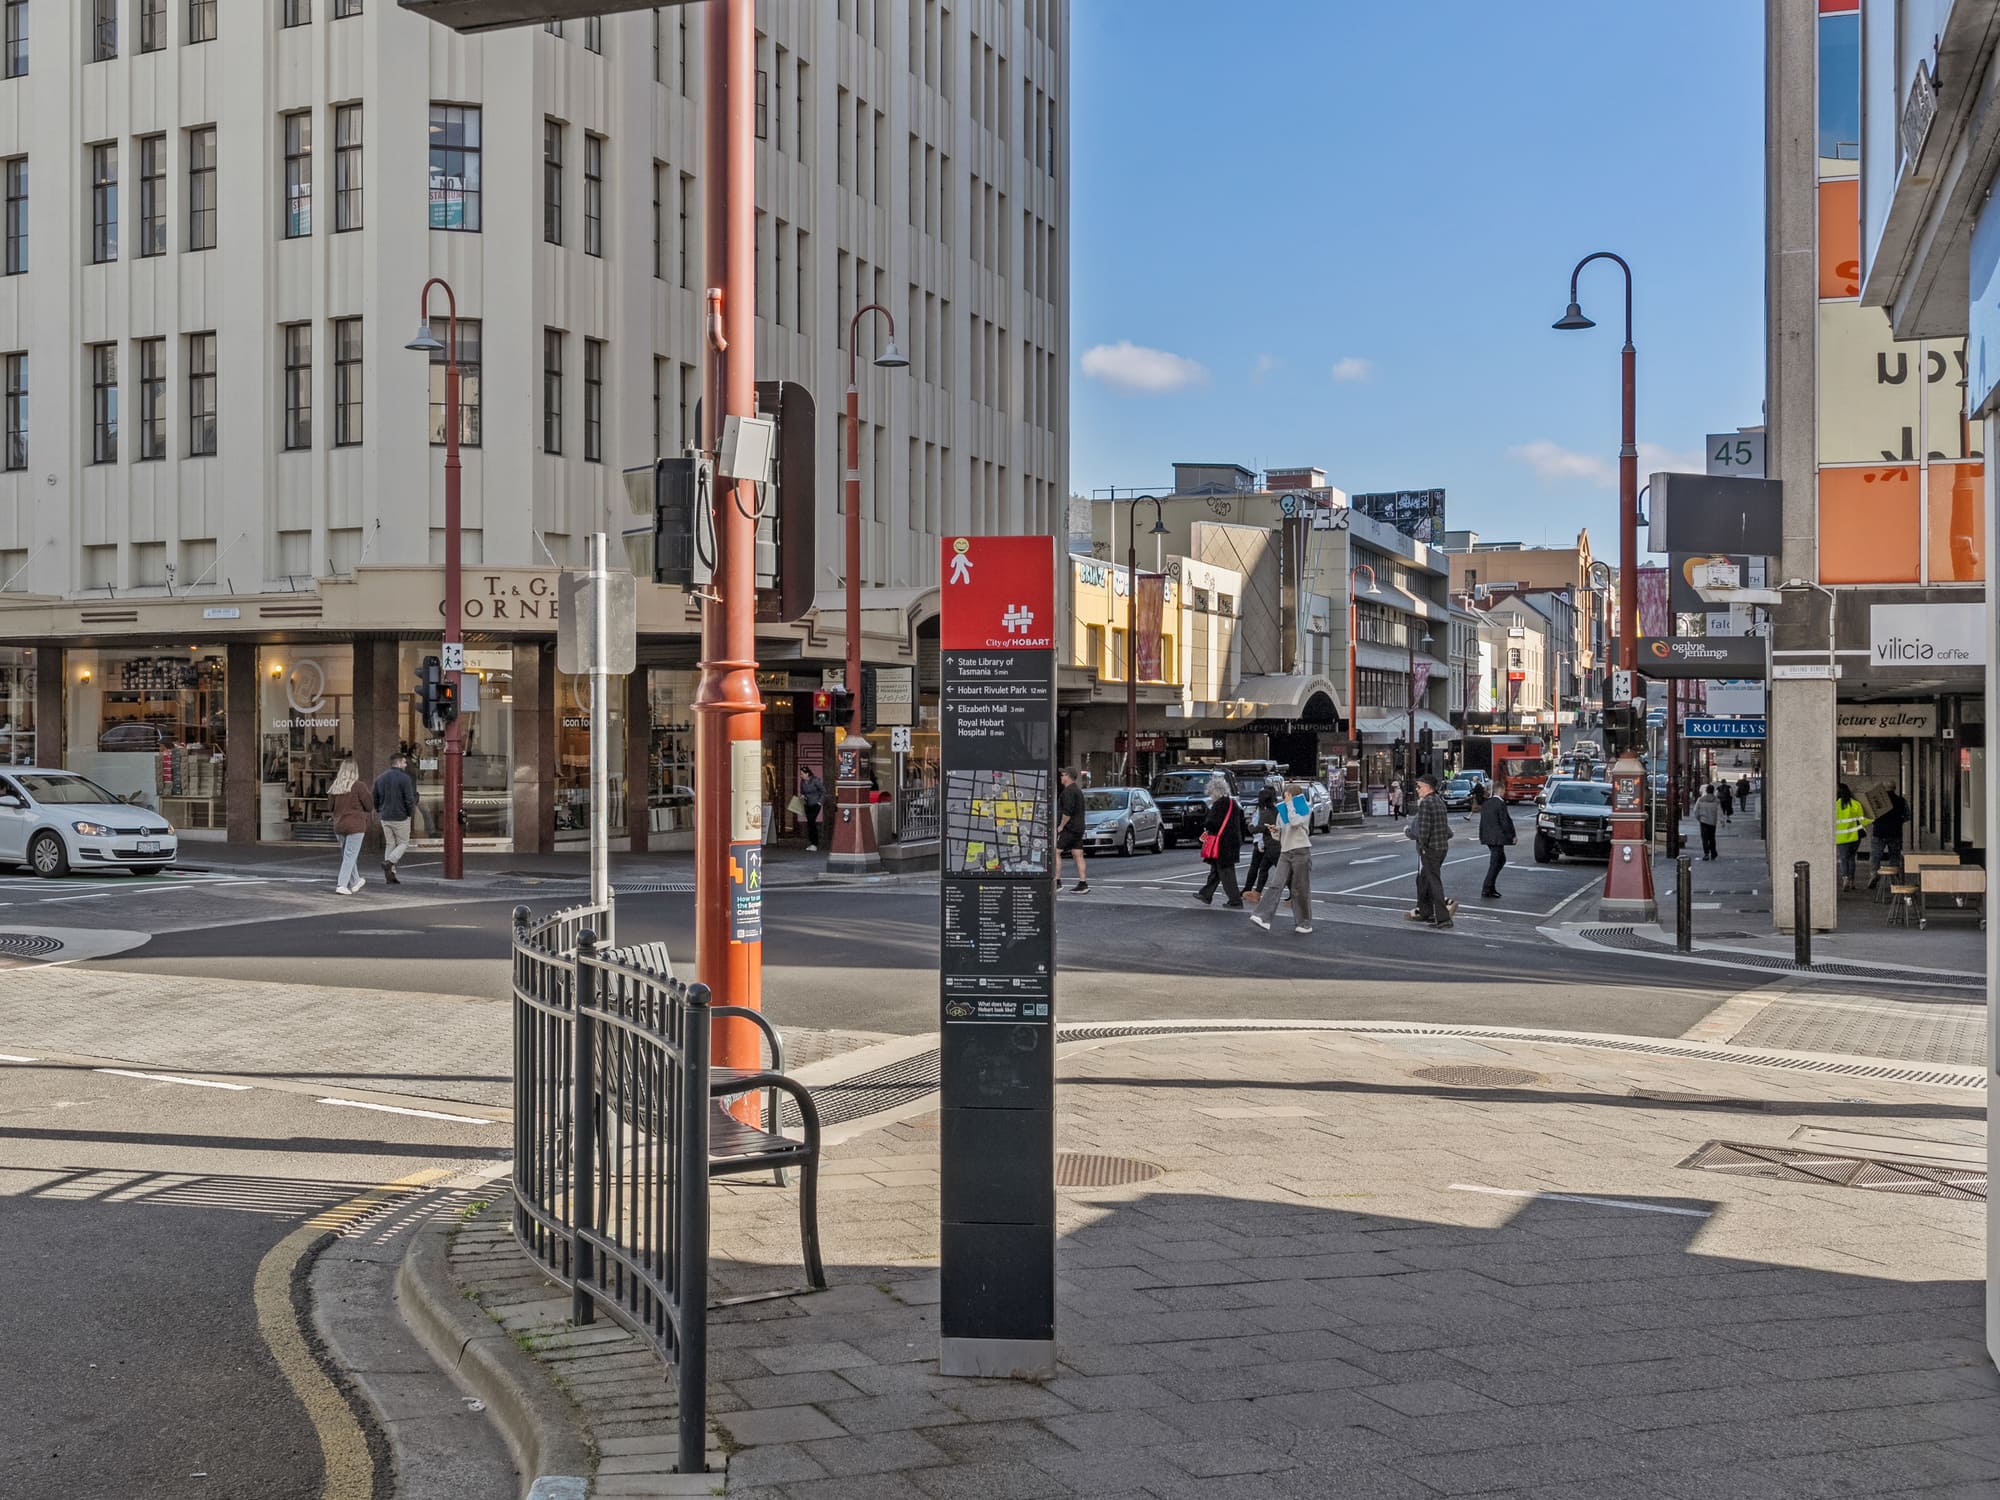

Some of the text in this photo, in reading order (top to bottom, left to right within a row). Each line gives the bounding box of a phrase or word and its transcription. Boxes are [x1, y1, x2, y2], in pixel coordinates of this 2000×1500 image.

[1714, 440, 1752, 466] 45
[484, 576, 555, 596] T. & G.
[438, 599, 558, 619] ORNE
[1002, 639, 1011, 647] of
[1672, 641, 1705, 653] ogilvie
[1877, 637, 1969, 660] vilicia coffee
[1683, 649, 1728, 660] jennings
[958, 657, 1014, 667] State Library of
[959, 667, 991, 676] Tasmania
[958, 686, 982, 695] Hobart
[984, 685, 1009, 695] Rivulet
[1010, 686, 1027, 694] Park
[958, 704, 990, 713] Elizabeth
[992, 705, 1008, 713] Mall
[272, 717, 340, 728] icon footwear
[562, 717, 579, 727] icon
[958, 718, 1005, 728] Royal Hobart
[1838, 713, 1928, 728] icture gallery
[958, 728, 987, 737] Hospital
[1693, 723, 1765, 733] ROUTLEYS
